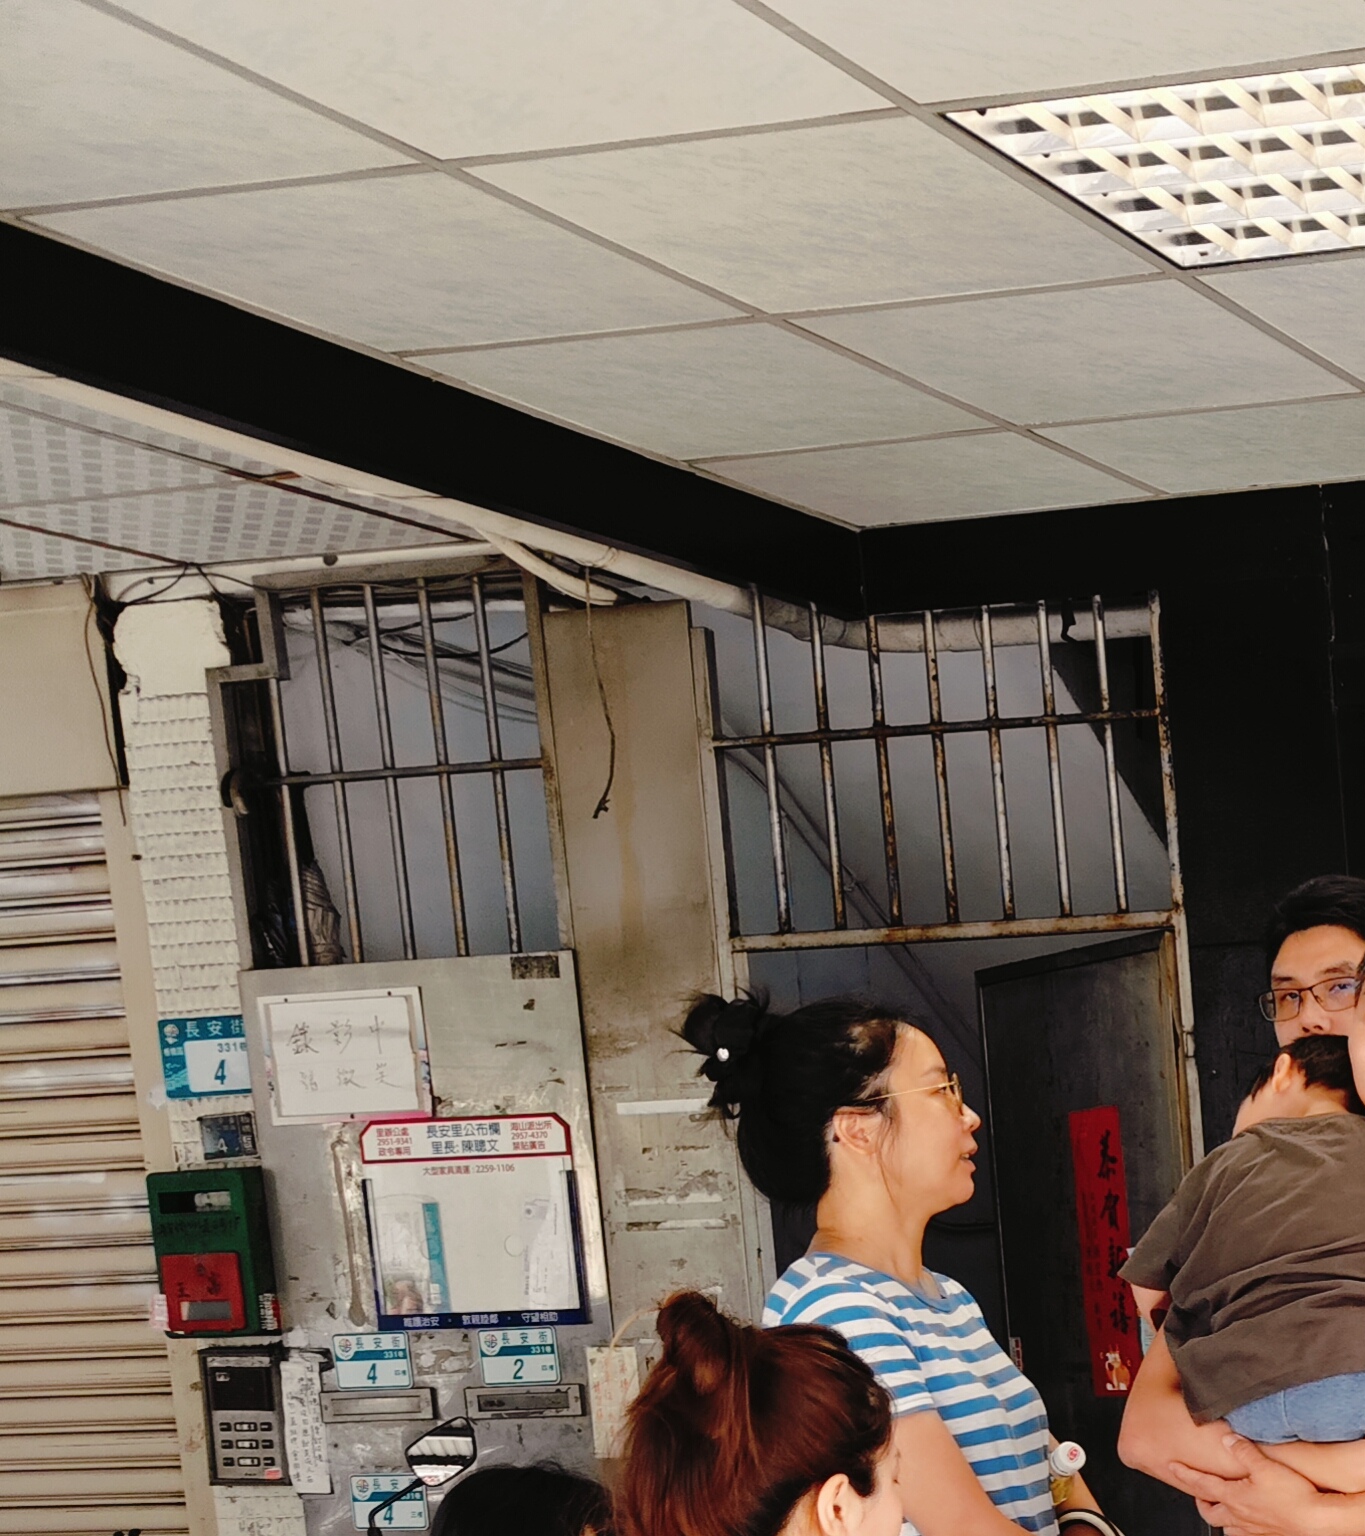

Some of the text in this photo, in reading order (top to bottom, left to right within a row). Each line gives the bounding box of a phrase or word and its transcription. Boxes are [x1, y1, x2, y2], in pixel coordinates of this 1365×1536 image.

[185, 1019, 244, 1038] 長安街
[286, 1015, 386, 1055] 錄影中
[214, 1059, 227, 1085] 4
[426, 1122, 501, 1139] 長安里公布欄
[512, 1131, 547, 1140] 2957-4370
[377, 1137, 412, 1146] 2951-9341
[367, 1363, 377, 1384] 4
[513, 1359, 524, 1380] 2
[383, 1504, 393, 1525] 4
